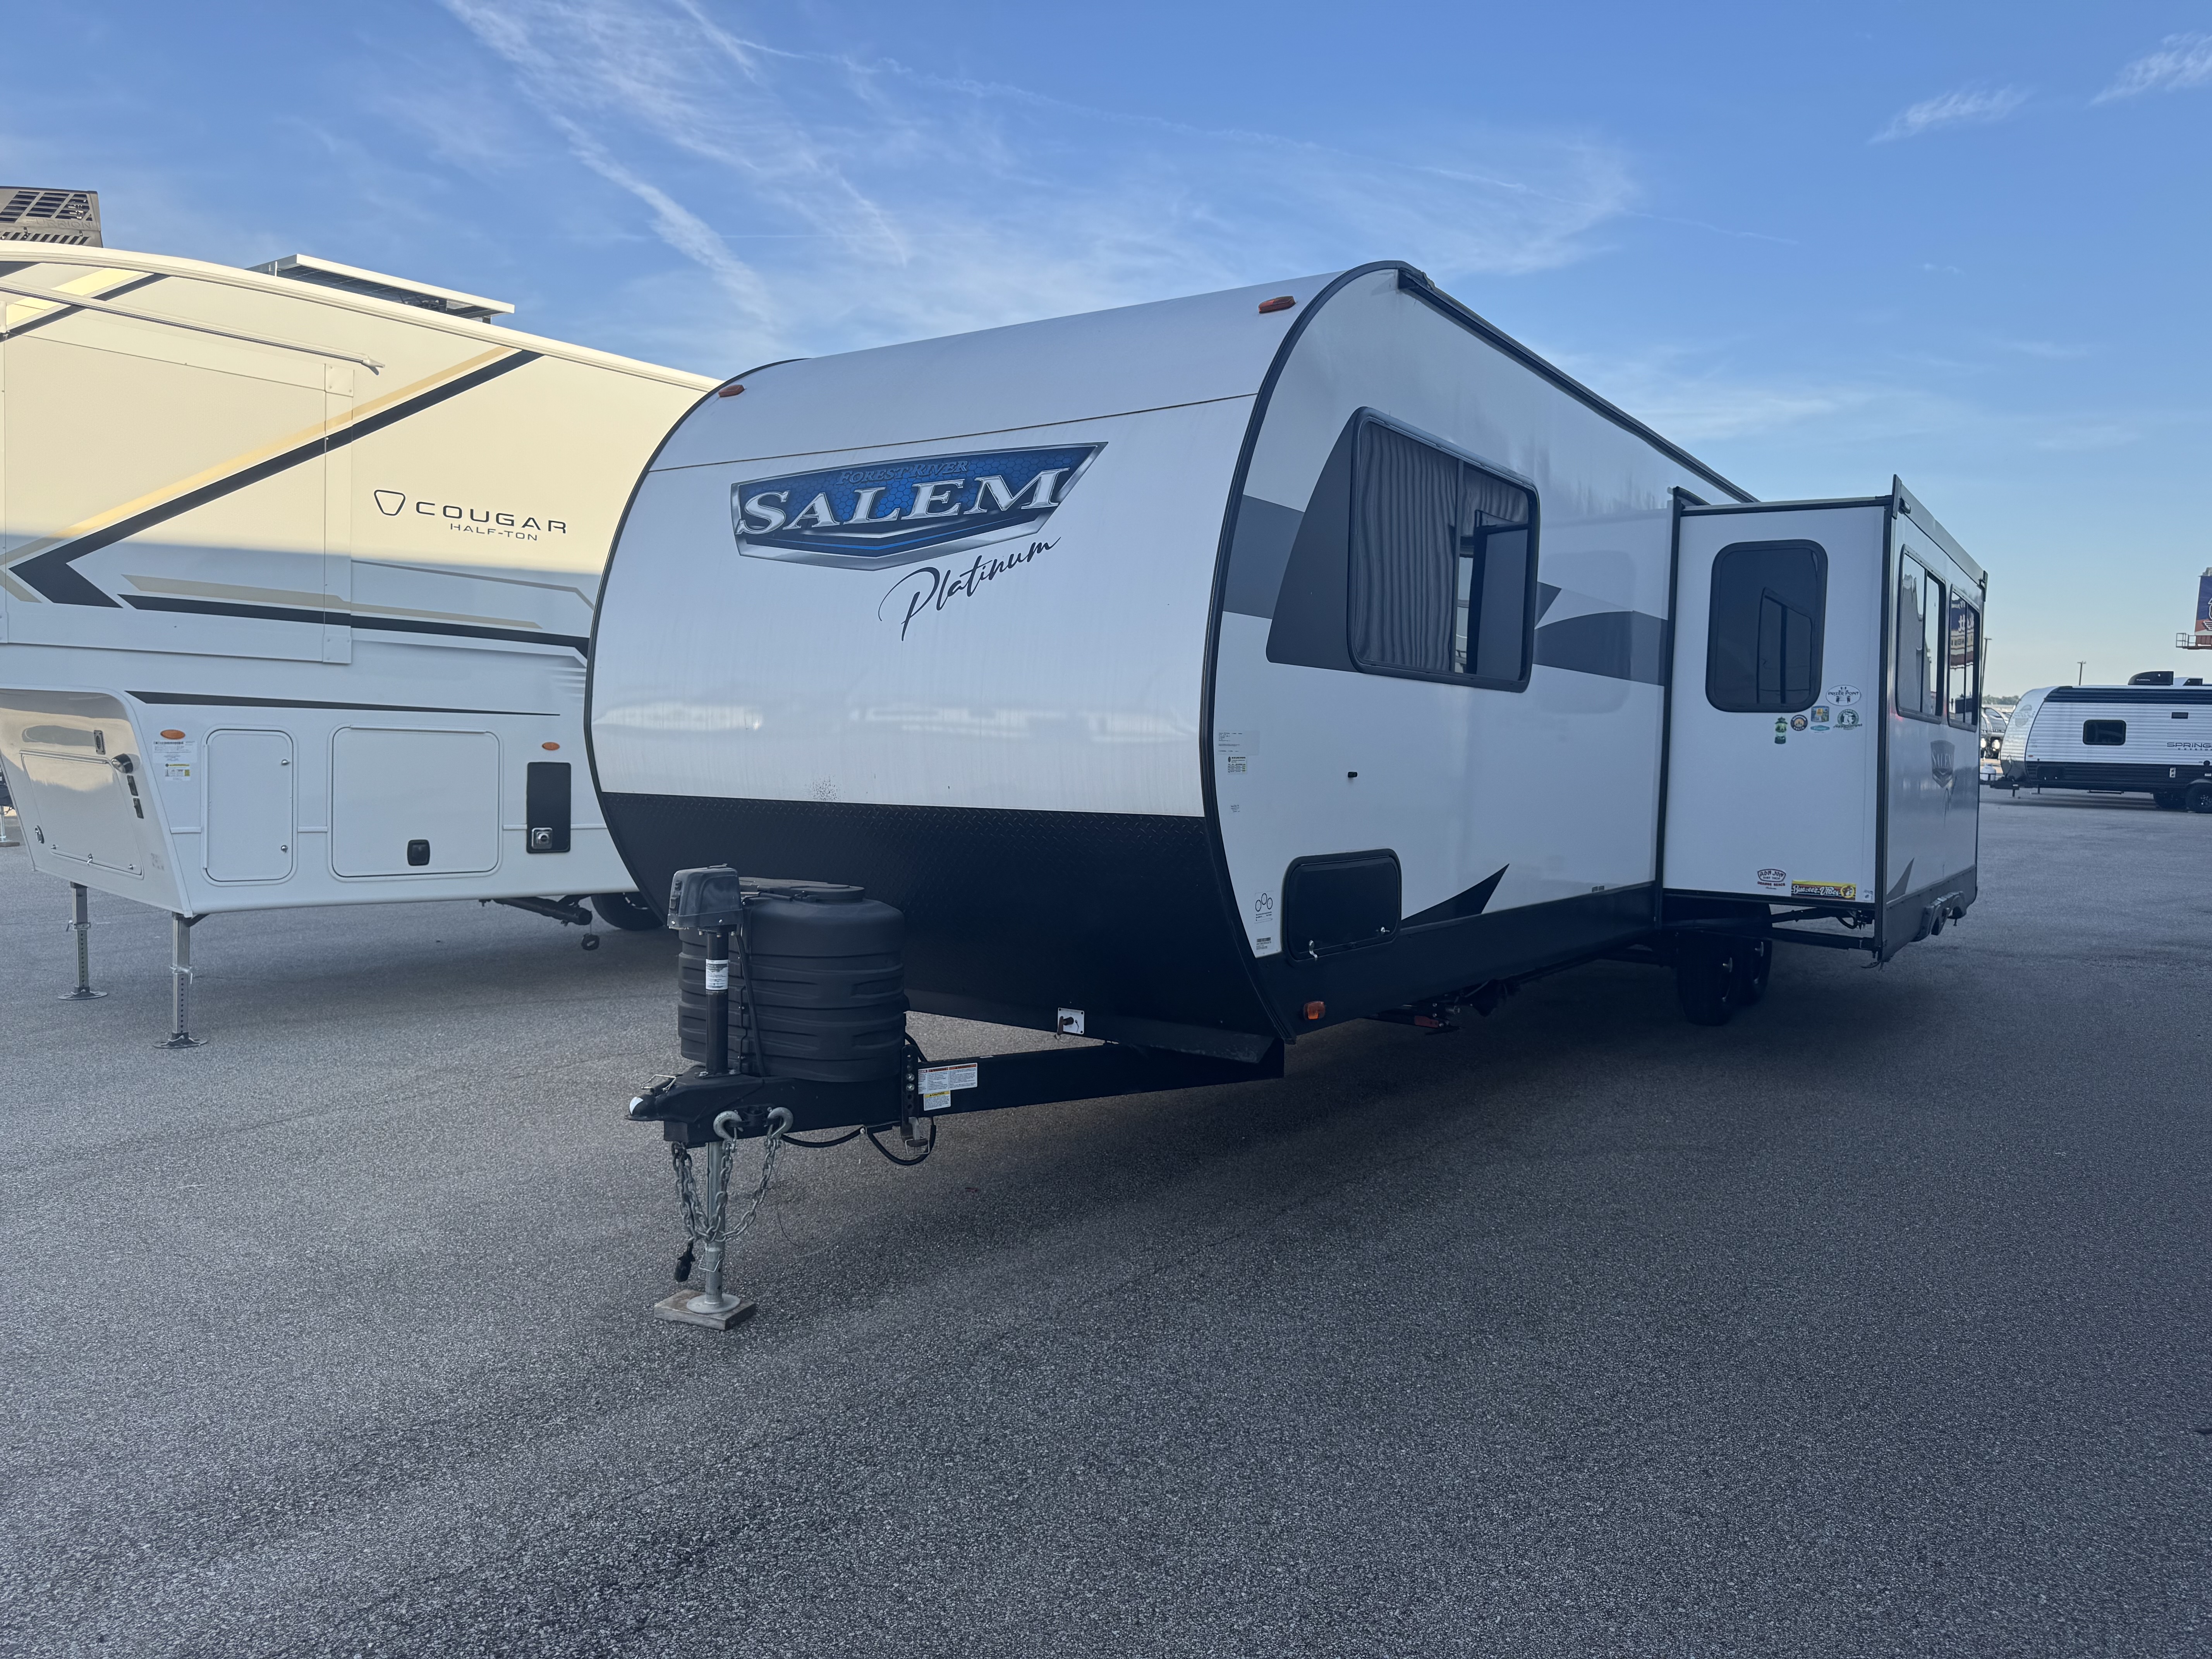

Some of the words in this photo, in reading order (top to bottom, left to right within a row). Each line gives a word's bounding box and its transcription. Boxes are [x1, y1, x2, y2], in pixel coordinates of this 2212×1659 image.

[26, 218, 91, 229] FURRION
[836, 466, 910, 484] FOREST
[909, 460, 968, 478] RIVER
[735, 467, 1070, 535] SALEM
[416, 501, 567, 534] COUGAR
[450, 523, 538, 541] HALF-TON
[878, 536, 1061, 641] Platinum
